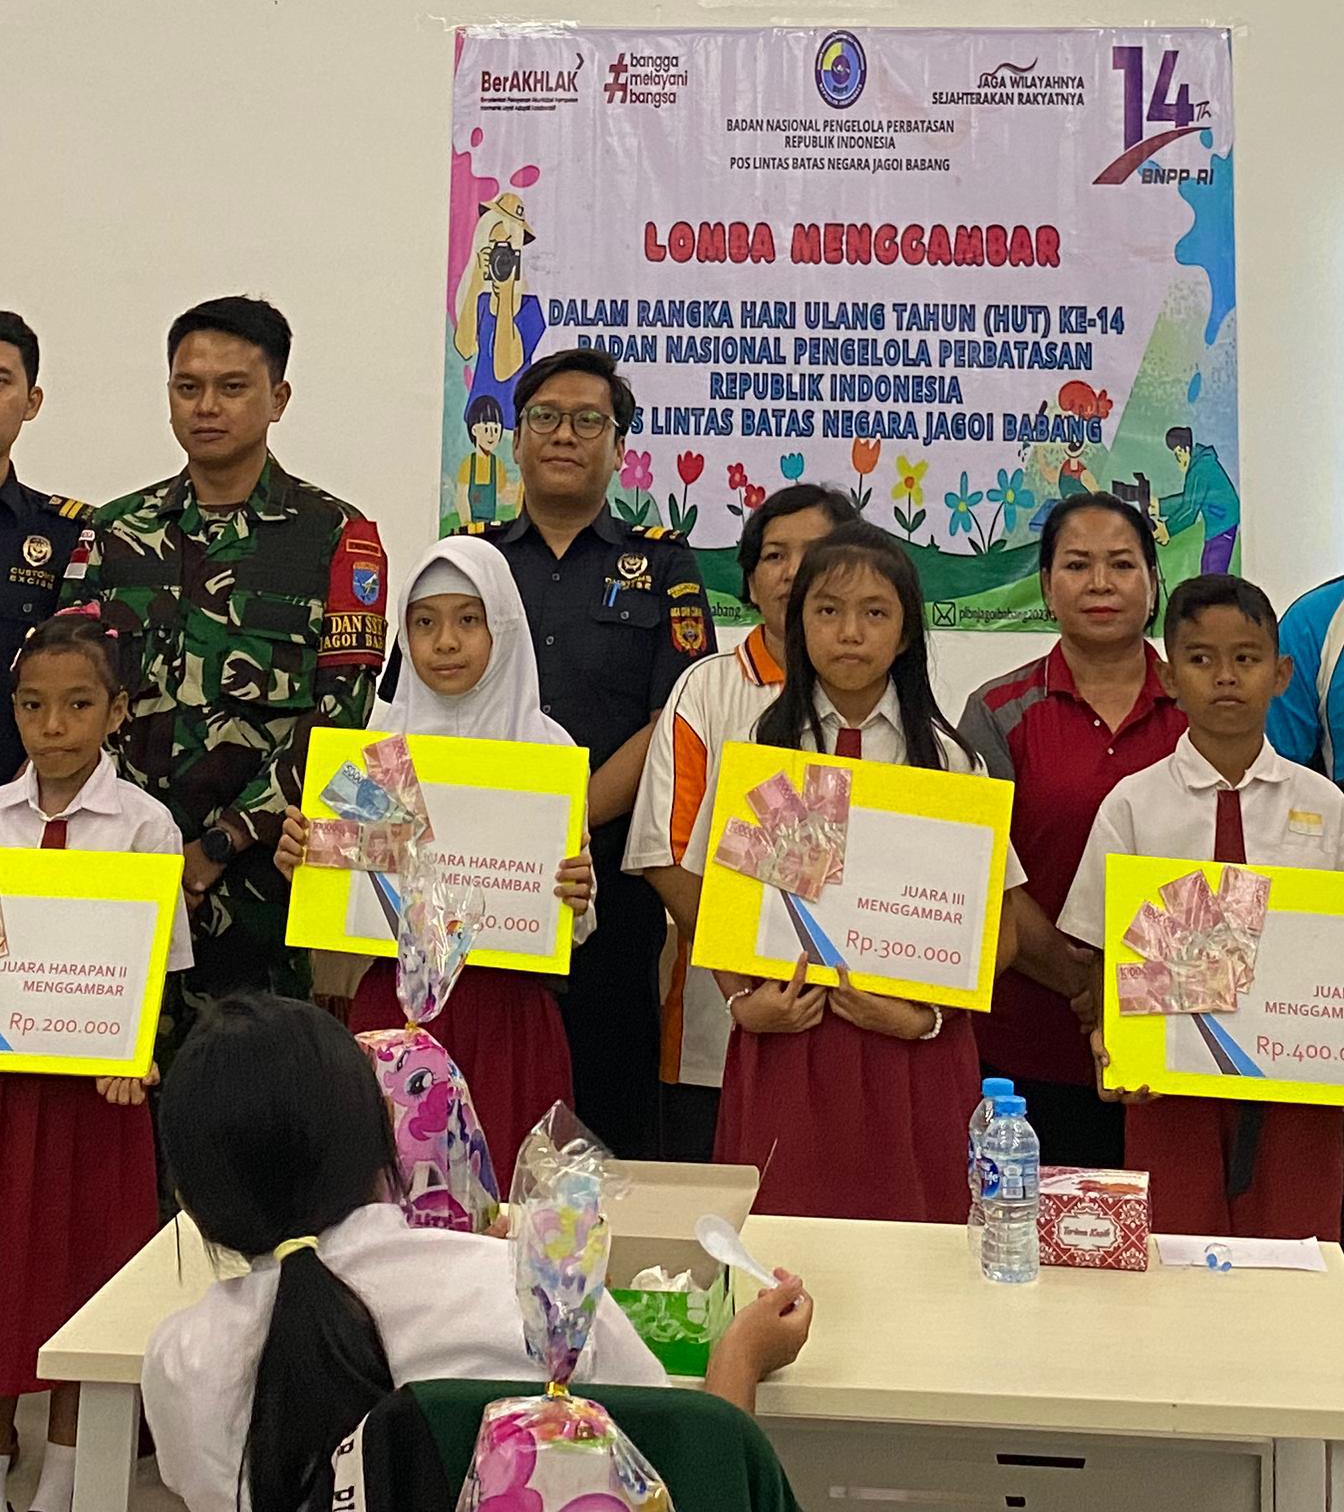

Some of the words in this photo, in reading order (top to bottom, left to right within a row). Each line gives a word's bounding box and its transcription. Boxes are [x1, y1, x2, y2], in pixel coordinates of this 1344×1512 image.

[630, 53, 679, 71] bangga
[481, 71, 579, 93] BerAKHLAK
[629, 70, 689, 90] melayani
[978, 74, 1007, 89] JAGA
[1009, 75, 1085, 90] WILAYAHNYA
[629, 90, 677, 109] bangsa
[932, 91, 1015, 106] SEJAHTERAKAN
[1017, 92, 1085, 106] RAKYATNYA
[1112, 46, 1194, 150] 14
[726, 118, 764, 133] BADAN
[766, 119, 821, 133] NASIONAL
[823, 119, 885, 134] PENGELOLA
[887, 119, 955, 134] PERBATASAN
[784, 135, 835, 149] REPUBLIK
[837, 136, 896, 150] INDONESIA
[730, 156, 751, 170] POS
[753, 157, 790, 171] LINTAS
[792, 157, 825, 171] BATAS
[827, 158, 871, 171] NEGARA
[872, 158, 903, 175] JAGOI
[905, 158, 951, 172] BABANG
[1141, 168, 1190, 185] BNPP
[644, 220, 776, 265] LOMBA
[790, 222, 1061, 268] MENGGAMBAR
[548, 299, 629, 327] DALAM
[637, 300, 733, 329] RANGKA
[740, 301, 796, 330] HARI
[805, 301, 885, 332] ULANG
[892, 303, 976, 333] TAHUN
[983, 304, 1051, 339] (HUT)
[1059, 305, 1125, 335] KE-14
[665, 335, 786, 365] NASIONAL
[793, 337, 932, 369] PENGELOLA
[938, 340, 1093, 371] PERBATASAN
[710, 372, 825, 402] REPUBLIK
[830, 374, 964, 405] INDONESIA
[651, 407, 734, 437] LINTAS
[741, 408, 815, 438] BATAS
[822, 410, 919, 440] NEGARA
[923, 412, 994, 445] JAGOI
[1002, 413, 1102, 444] BABANG
[330, 615, 363, 634] DAN
[424, 852, 466, 867] UARA
[469, 856, 536, 874] HARAPAN
[538, 863, 544, 875] I
[440, 872, 542, 894] MENGGAMBAR
[900, 884, 948, 904] JUARA
[951, 891, 966, 906] III
[857, 896, 964, 925] MENGGAMBAR
[845, 928, 962, 966] Rp.300.000
[0, 960, 45, 975] JUARA
[48, 962, 116, 977] HARAPAN
[118, 965, 128, 978] II
[22, 979, 125, 997] MENGGAMBAR
[9, 1011, 121, 1037] Rp.200.000
